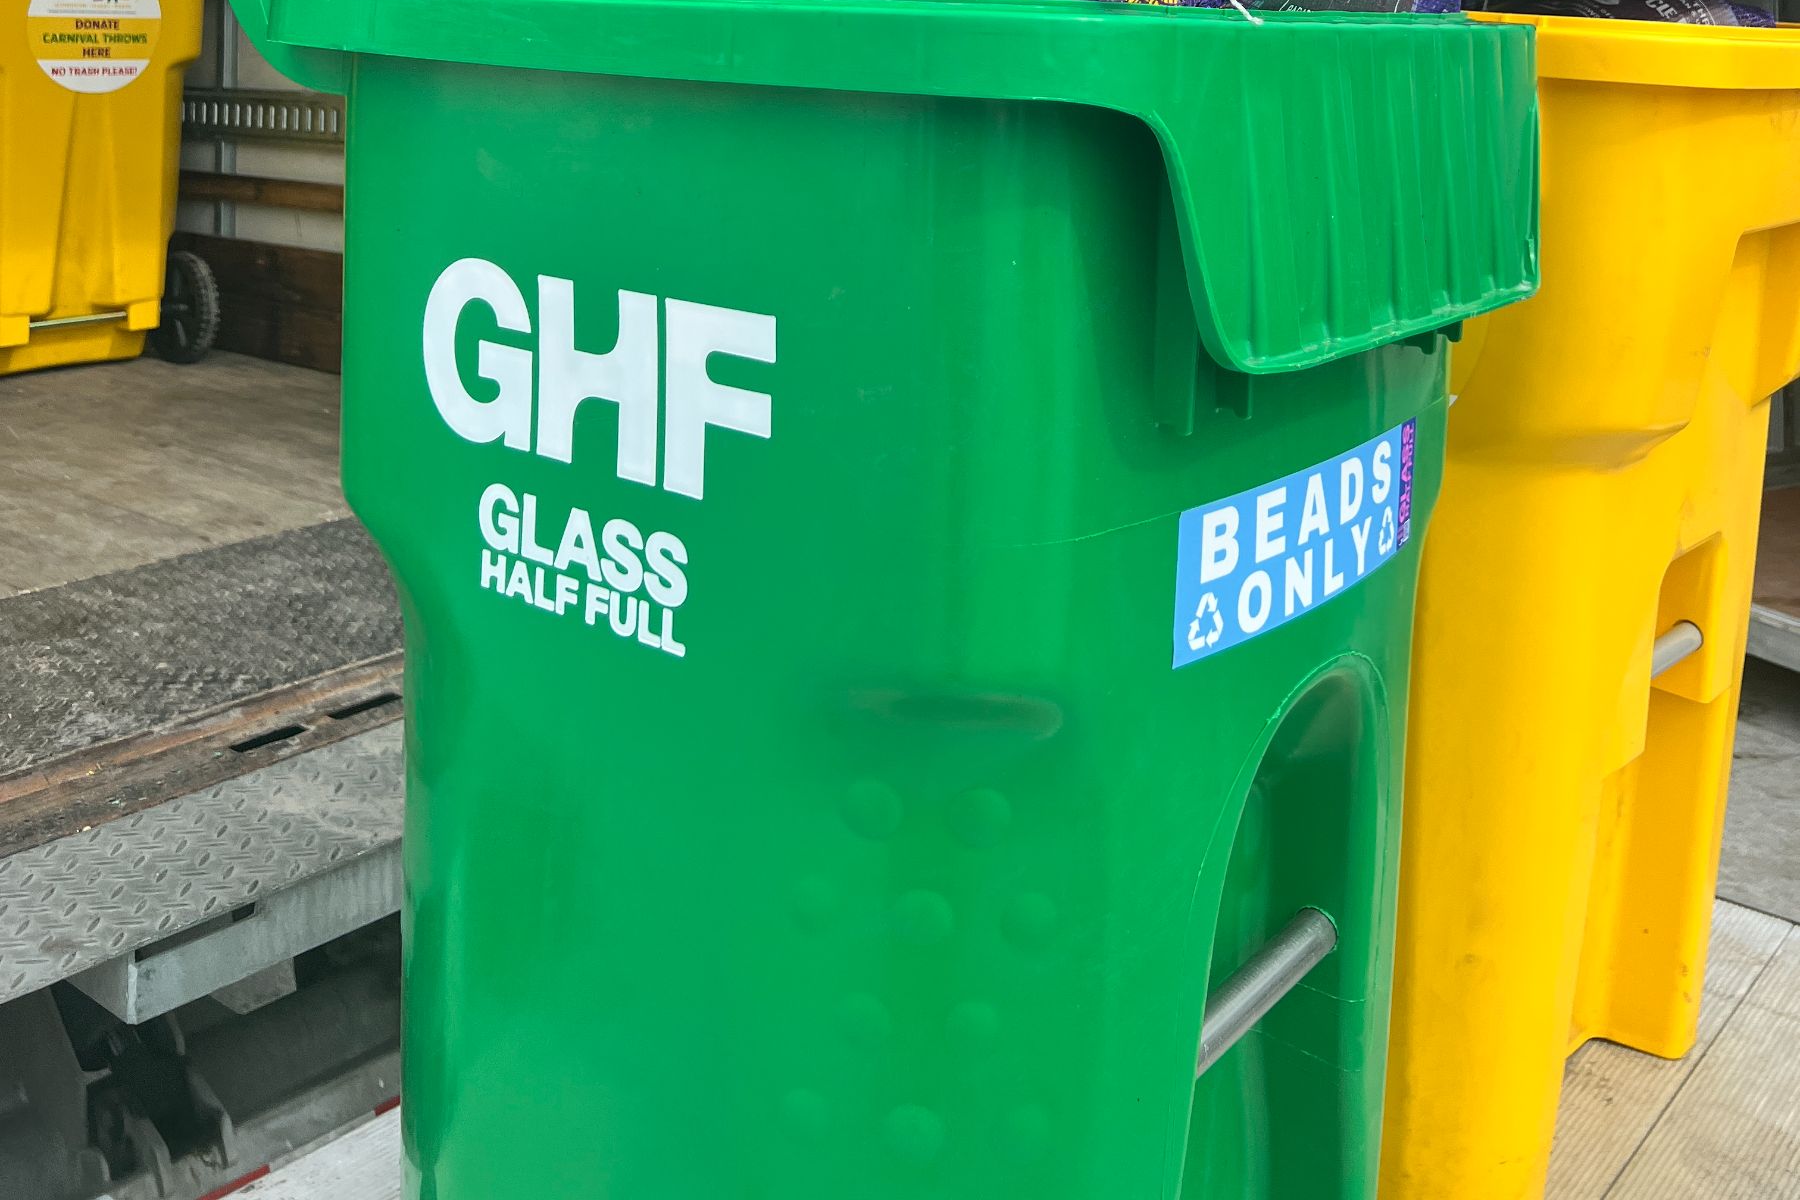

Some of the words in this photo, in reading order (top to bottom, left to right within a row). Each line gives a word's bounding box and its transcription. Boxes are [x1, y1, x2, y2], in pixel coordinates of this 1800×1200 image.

[42, 32, 100, 45] CARNIVAL
[104, 33, 147, 45] THROWS
[51, 67, 66, 77] NO
[69, 67, 100, 77] TRASH
[75, 19, 119, 31] DONATE
[82, 47, 111, 59] HERE
[422, 257, 777, 500] GHF
[478, 483, 689, 608] GLASS
[1200, 439, 1392, 585] BEADS
[480, 549, 579, 616] HALF
[584, 582, 686, 658] FULL
[1237, 516, 1373, 634] ONLY
